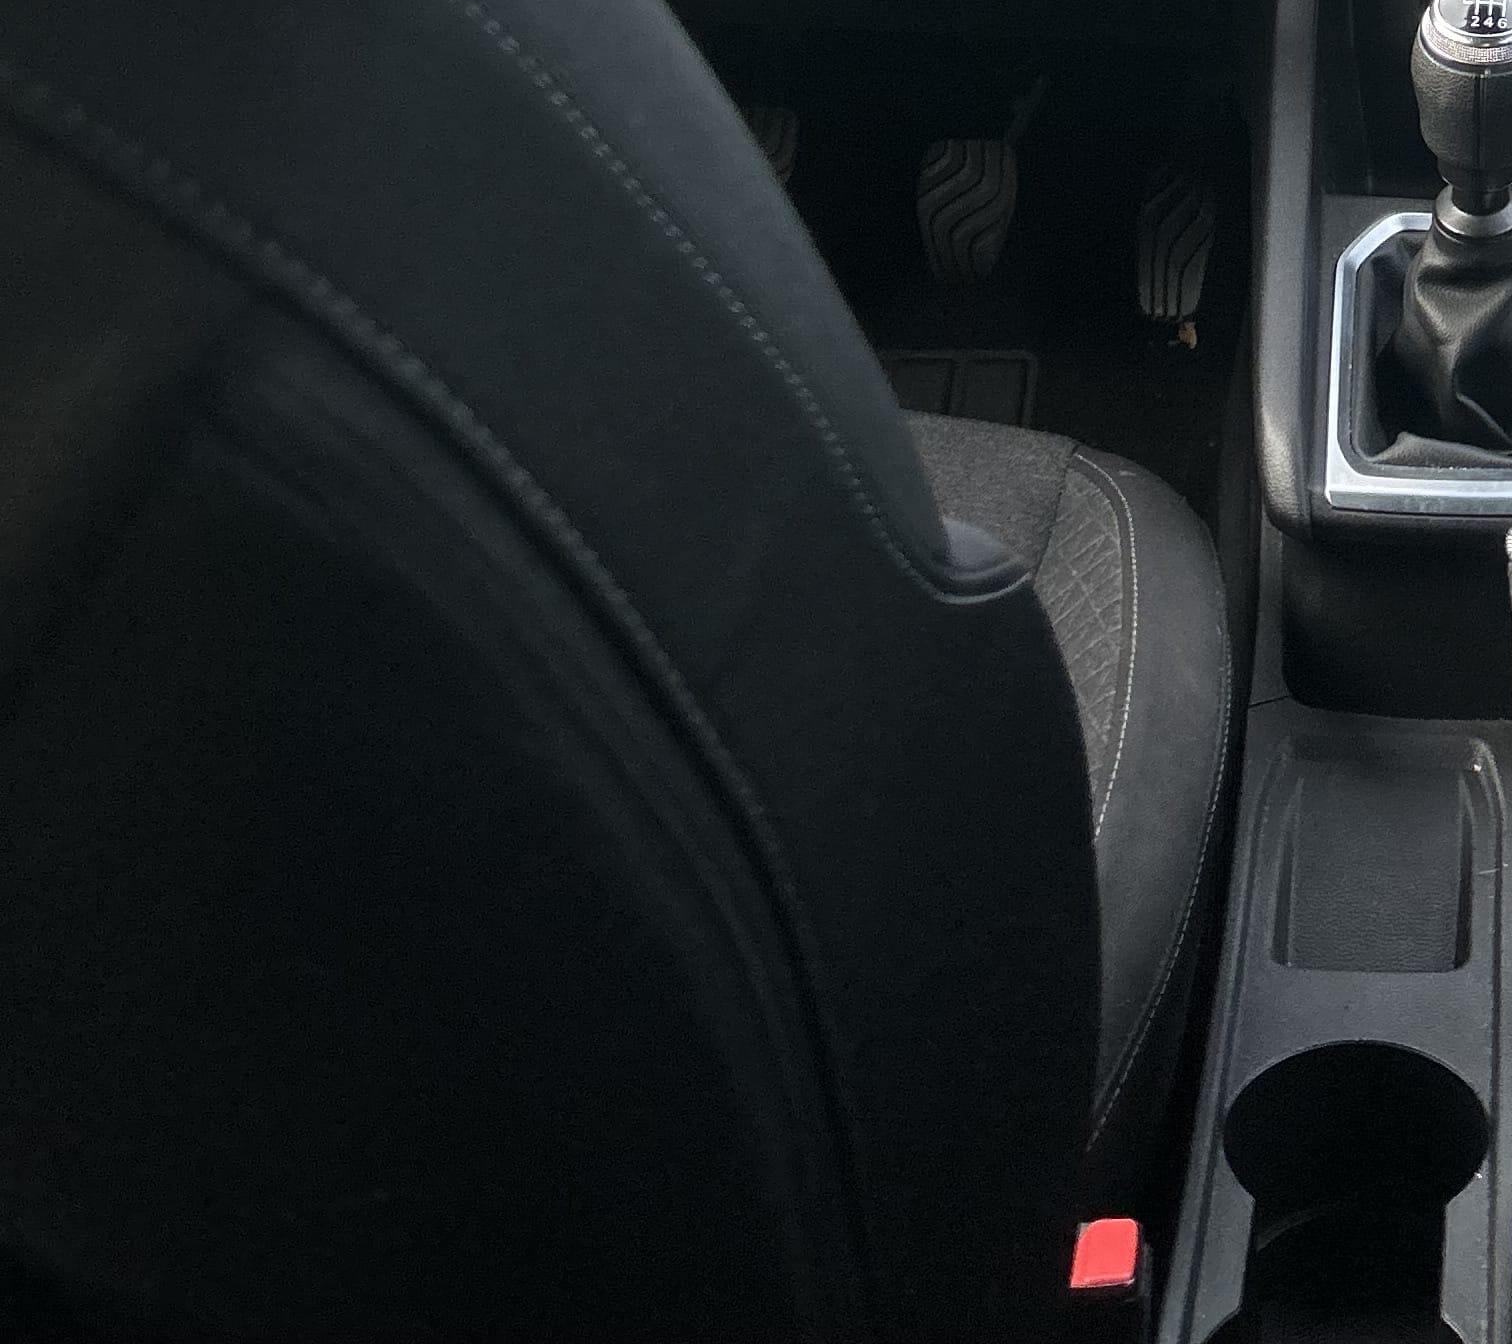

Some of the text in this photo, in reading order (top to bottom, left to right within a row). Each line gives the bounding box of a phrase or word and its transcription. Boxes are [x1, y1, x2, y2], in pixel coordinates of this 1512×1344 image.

[1470, 15, 1508, 29] 2 4 6
